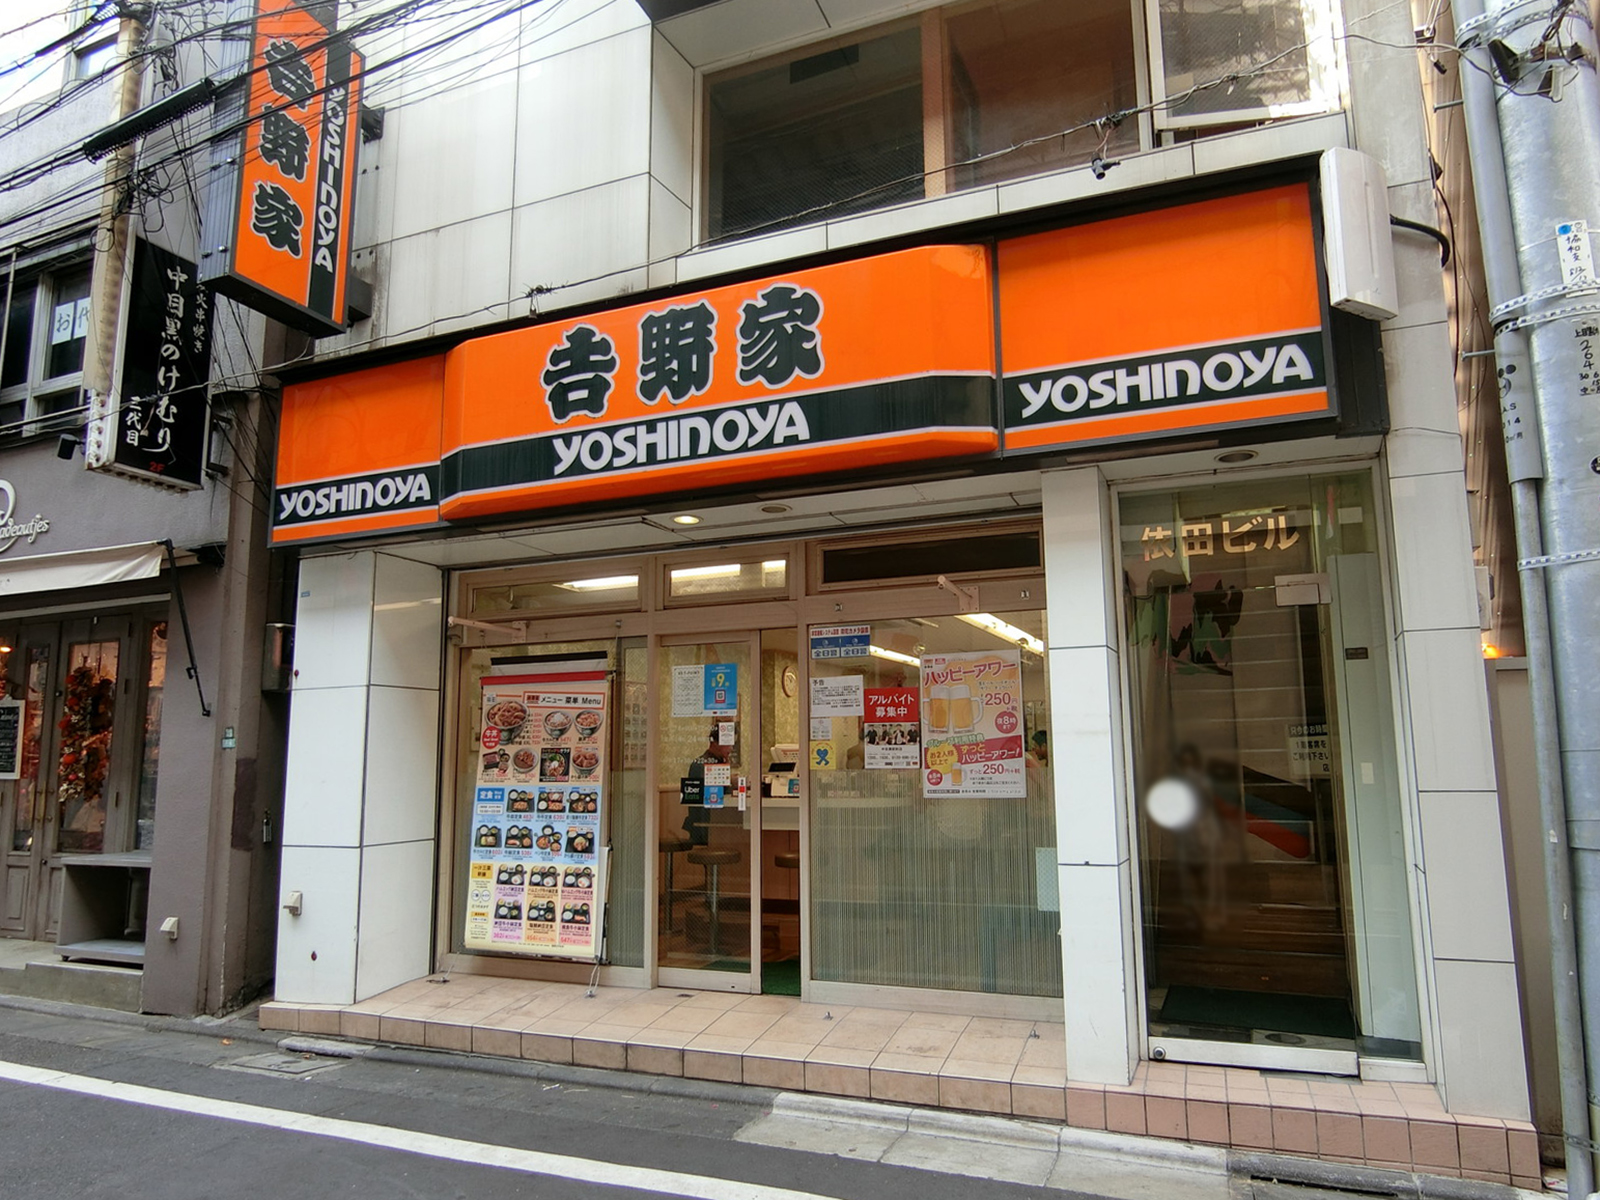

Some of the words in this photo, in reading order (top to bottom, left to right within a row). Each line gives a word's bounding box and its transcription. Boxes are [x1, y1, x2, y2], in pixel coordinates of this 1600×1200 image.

[250, 38, 317, 259] 吉野家
[314, 78, 346, 274] YOSHINOYA
[142, 265, 188, 452] 中目黒のけむり
[540, 282, 825, 424] 吉野家
[1018, 344, 1314, 419] YOSHINOYA
[125, 396, 142, 447] 三代目
[553, 402, 810, 476] YOSHINOYA
[149, 461, 166, 474] 2F
[279, 473, 431, 520] YOSHINOYA
[1140, 515, 1300, 562] 依田ビル
[923, 661, 1017, 687] ハッピーアワー
[540, 696, 563, 704] メニュー
[581, 697, 602, 706] Menu
[868, 694, 915, 706] アルバイト
[875, 706, 908, 718] 募集中
